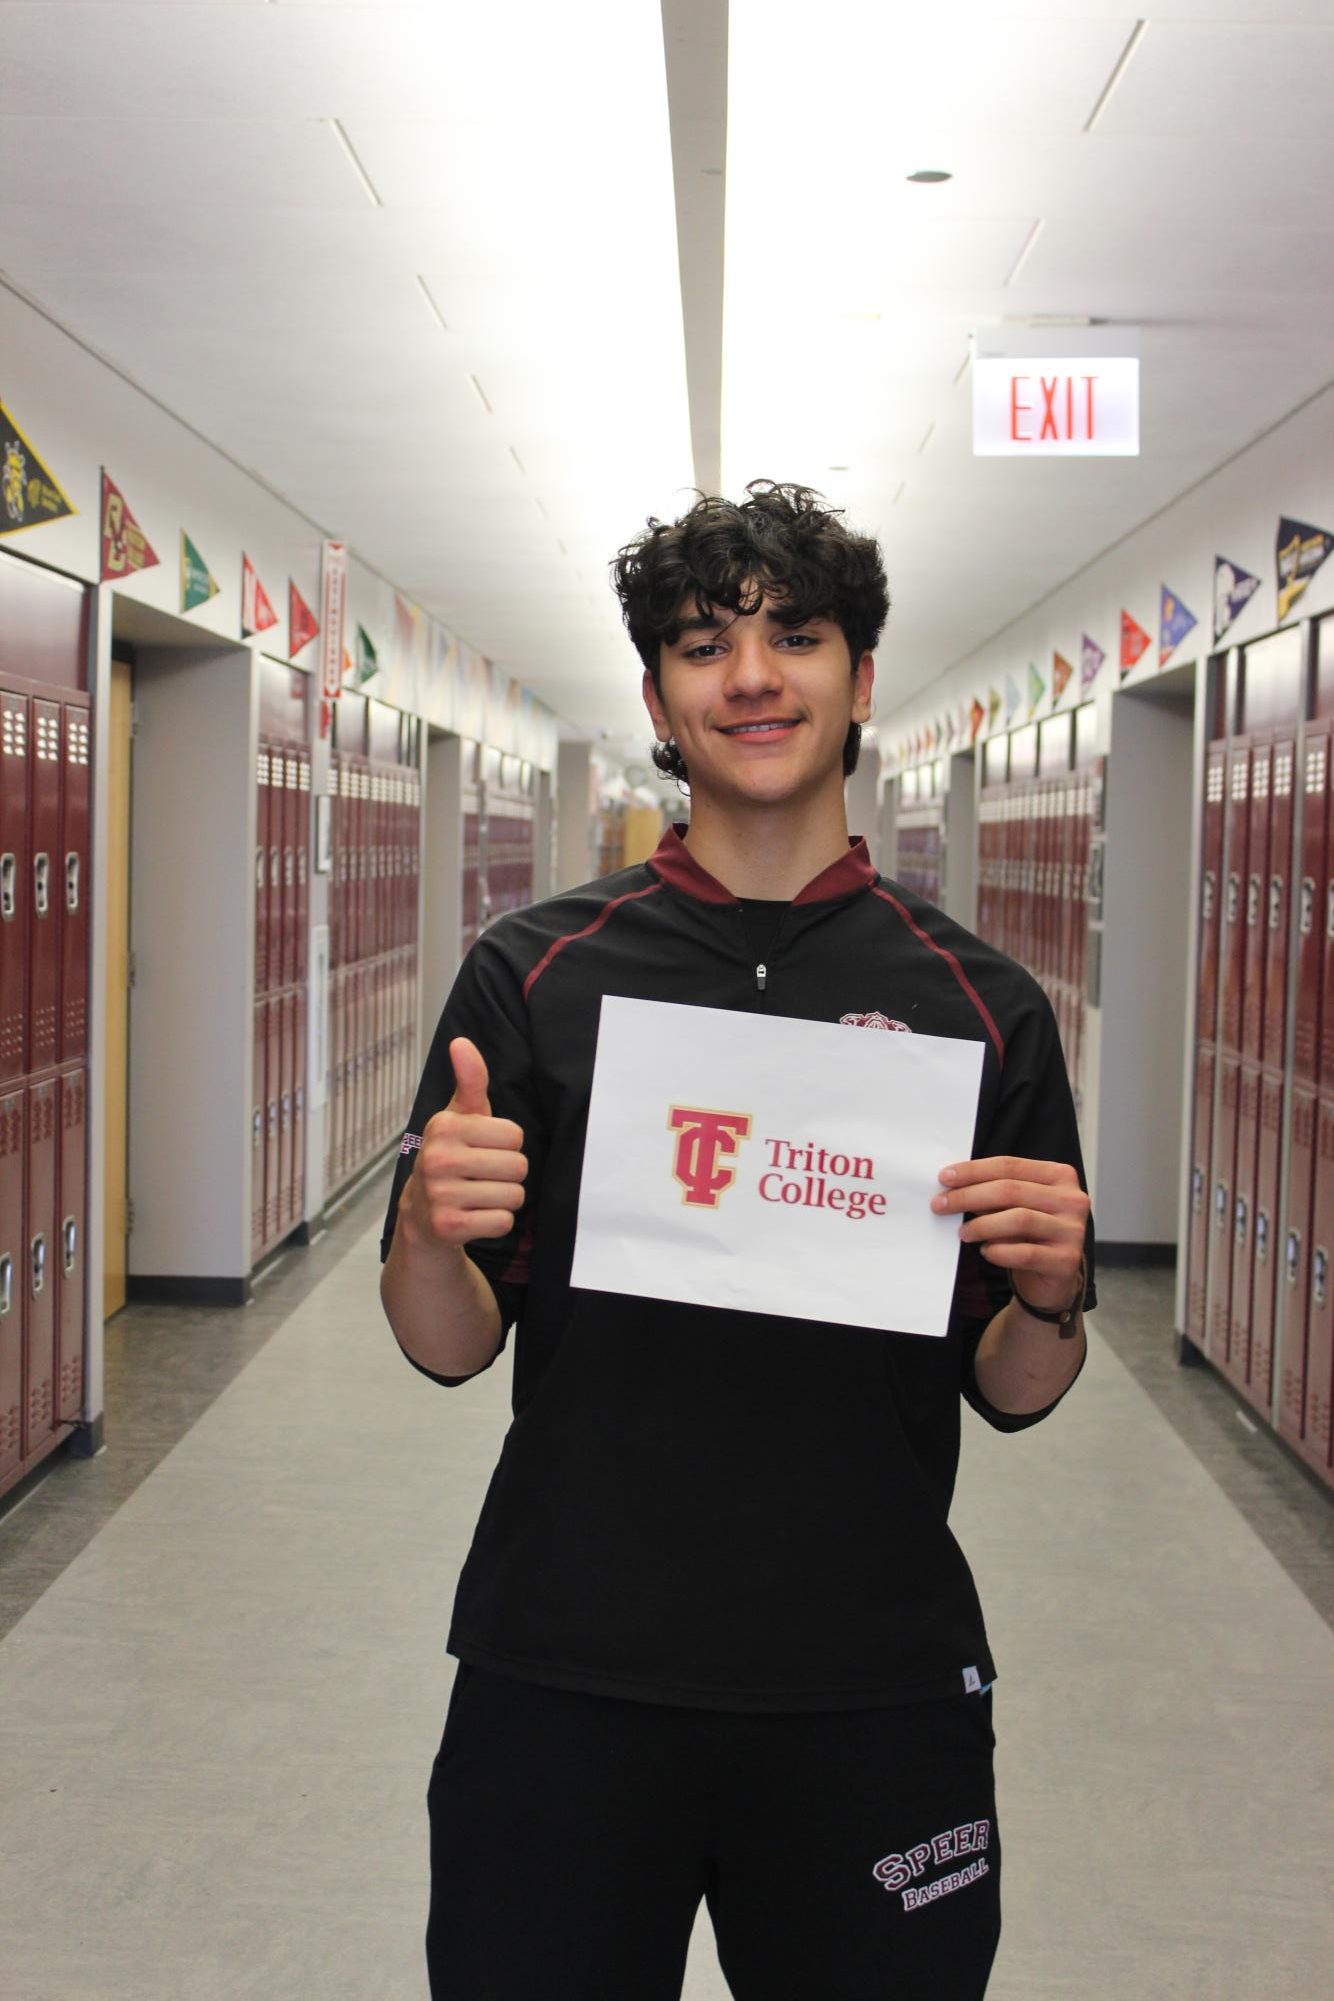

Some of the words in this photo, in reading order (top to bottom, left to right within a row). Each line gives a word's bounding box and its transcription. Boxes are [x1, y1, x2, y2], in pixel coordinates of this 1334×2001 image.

[1010, 376, 1099, 440] EXIT
[764, 1138, 875, 1181] Triton
[758, 1172, 887, 1220] College
[872, 1819, 990, 1892] SPEER
[901, 1856, 990, 1912] BASEBALL
